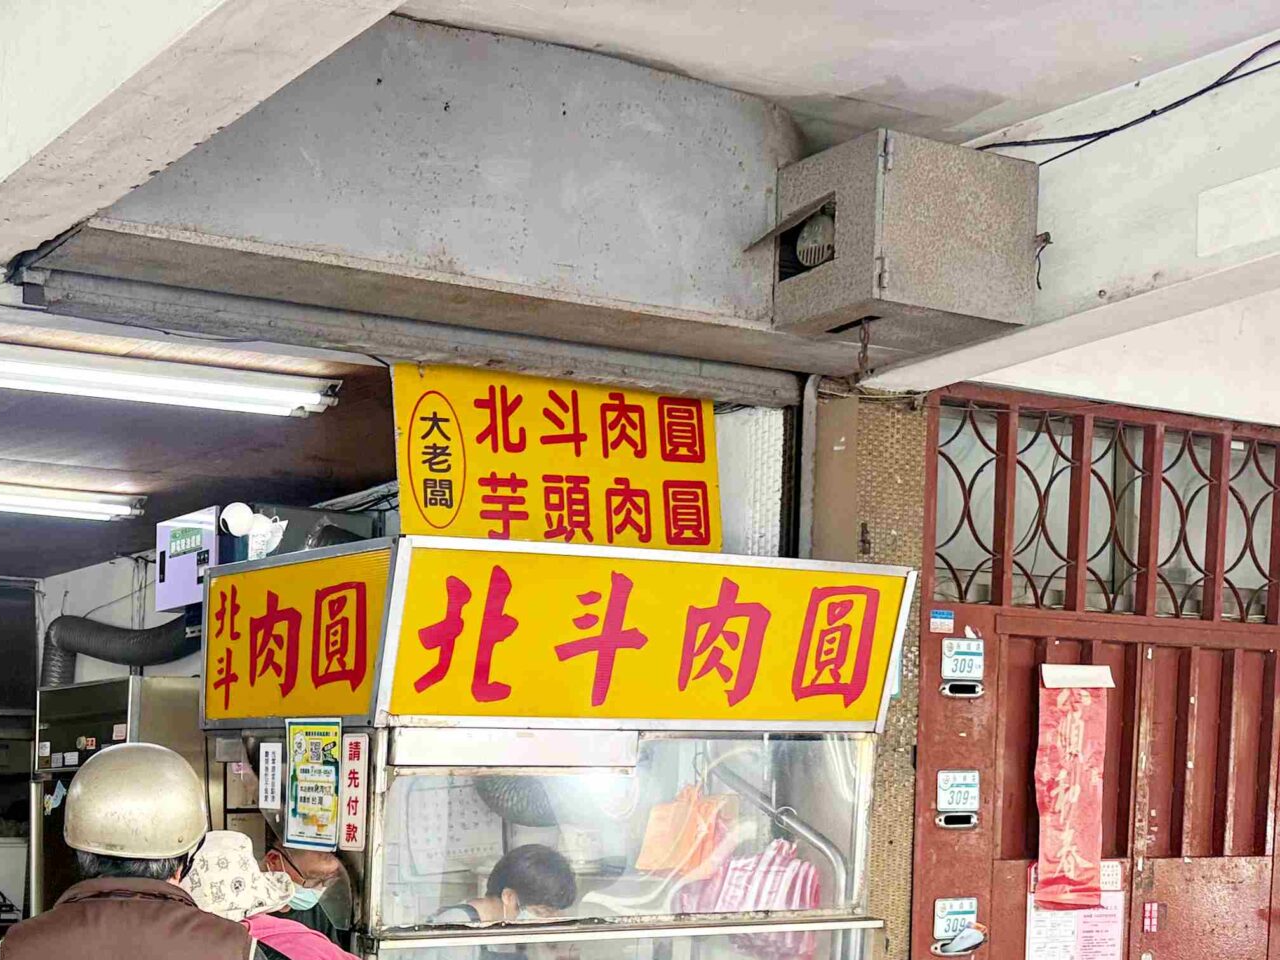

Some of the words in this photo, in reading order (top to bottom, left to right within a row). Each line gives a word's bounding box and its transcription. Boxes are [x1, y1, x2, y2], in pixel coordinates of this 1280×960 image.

[419, 410, 455, 511] 大老闆
[473, 384, 706, 464] 北斗肉圓
[477, 470, 712, 546] 芋頭肉圓
[413, 564, 880, 709] 北斗肉圓
[951, 658, 974, 674] 309
[345, 741, 361, 842] 請先付款
[947, 790, 970, 805] 309
